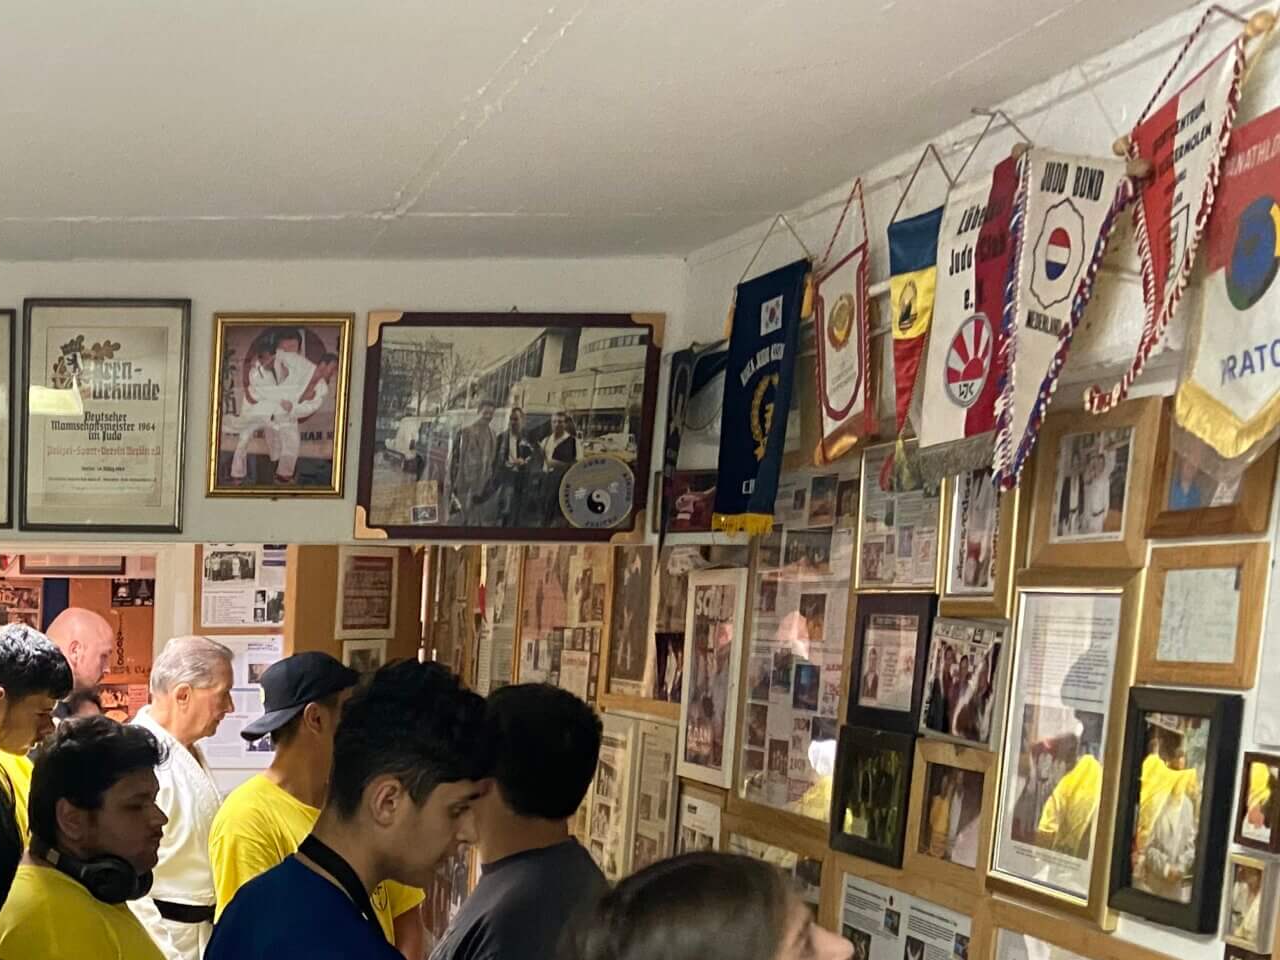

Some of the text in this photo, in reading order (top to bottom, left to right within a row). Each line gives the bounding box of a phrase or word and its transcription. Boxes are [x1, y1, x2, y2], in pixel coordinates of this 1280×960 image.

[1041, 161, 1104, 202] JUDO BOND
[949, 243, 972, 277] Judo
